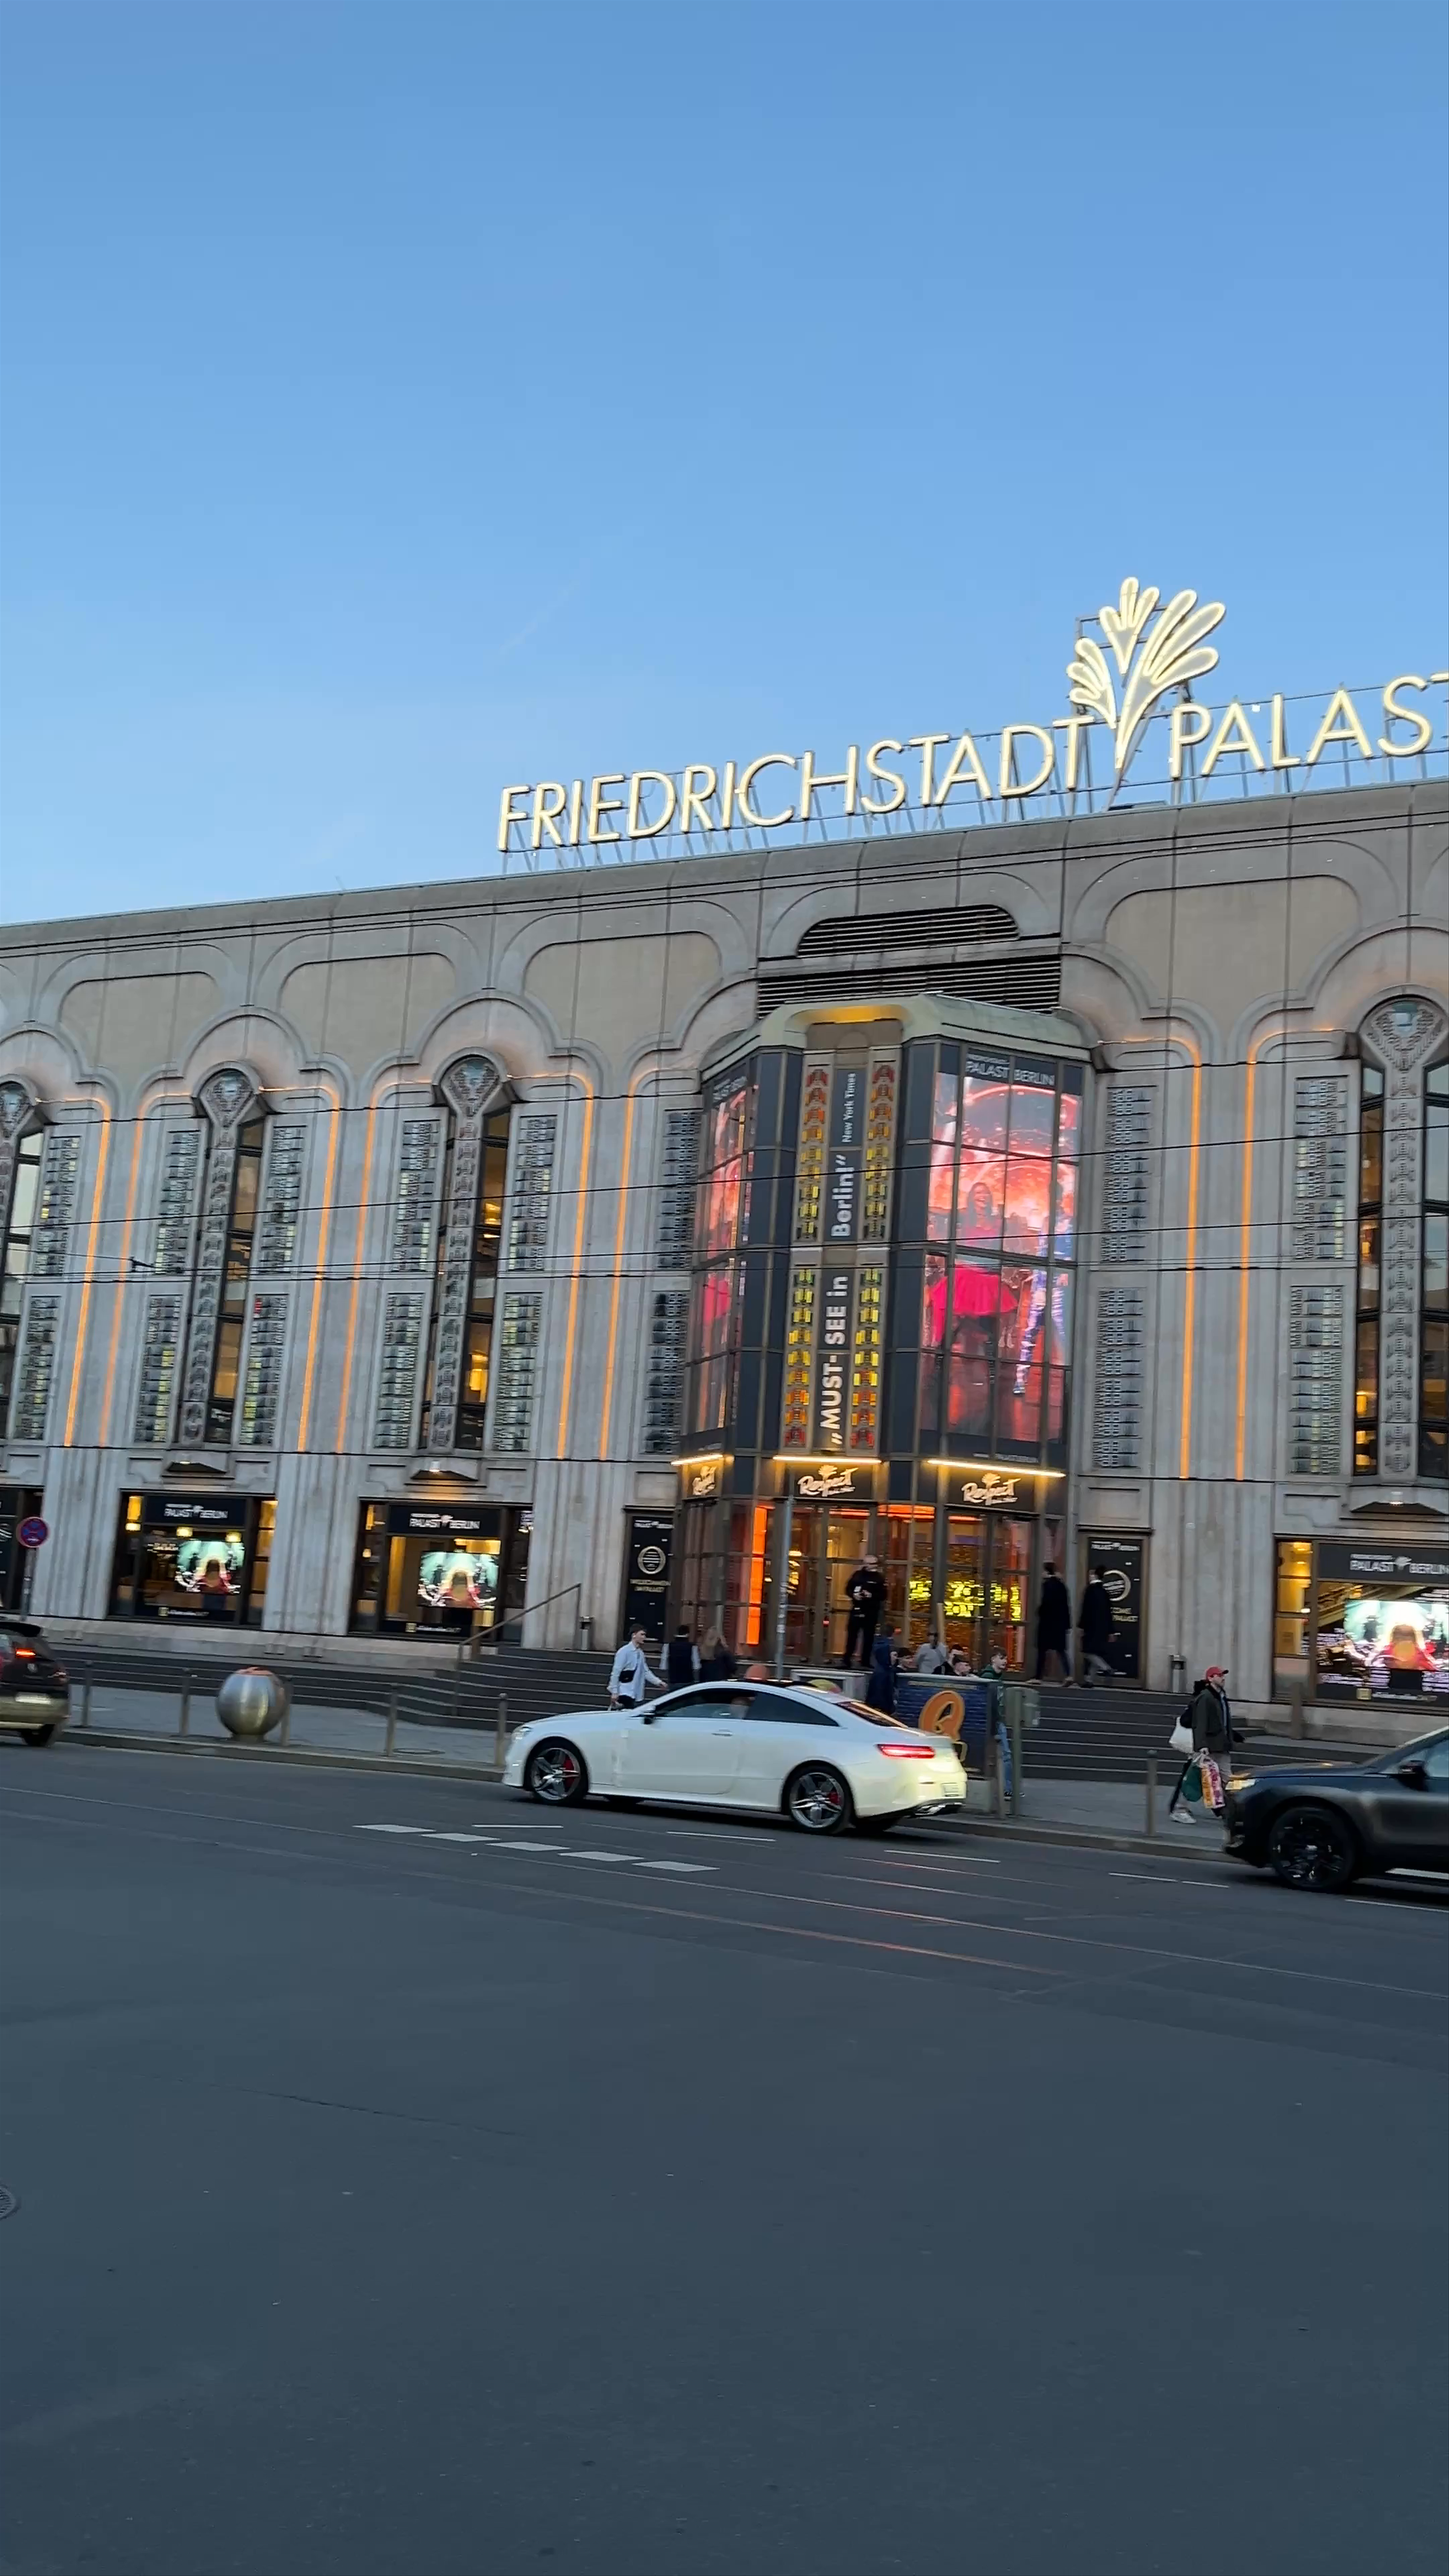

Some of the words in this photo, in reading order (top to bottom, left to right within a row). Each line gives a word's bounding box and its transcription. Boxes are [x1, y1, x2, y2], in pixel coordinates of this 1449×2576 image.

[497, 714, 1095, 852] FRIEDRICHSTADT
[965, 1061, 1010, 1078] PALAST
[1014, 1069, 1055, 1086] BERLIN
[843, 1100, 855, 1121] York
[842, 1122, 853, 1143] New
[826, 1276, 848, 1296] in
